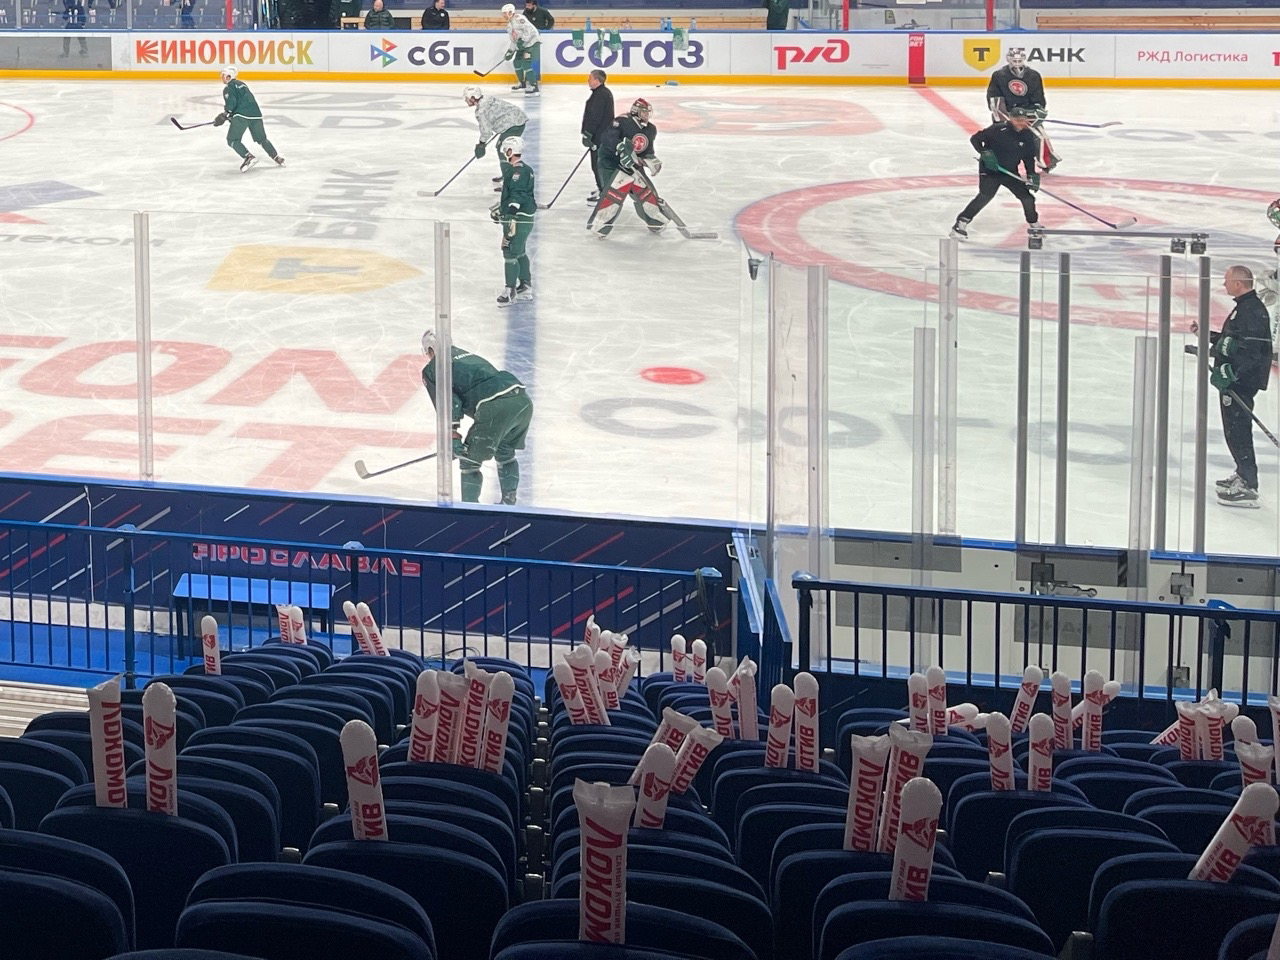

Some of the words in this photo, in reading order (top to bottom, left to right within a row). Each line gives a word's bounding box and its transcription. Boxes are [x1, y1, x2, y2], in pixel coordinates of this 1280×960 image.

[135, 39, 314, 65] КИНОПОИСК
[1137, 49, 1171, 64] РЖД
[1175, 49, 1249, 63] Логистика
